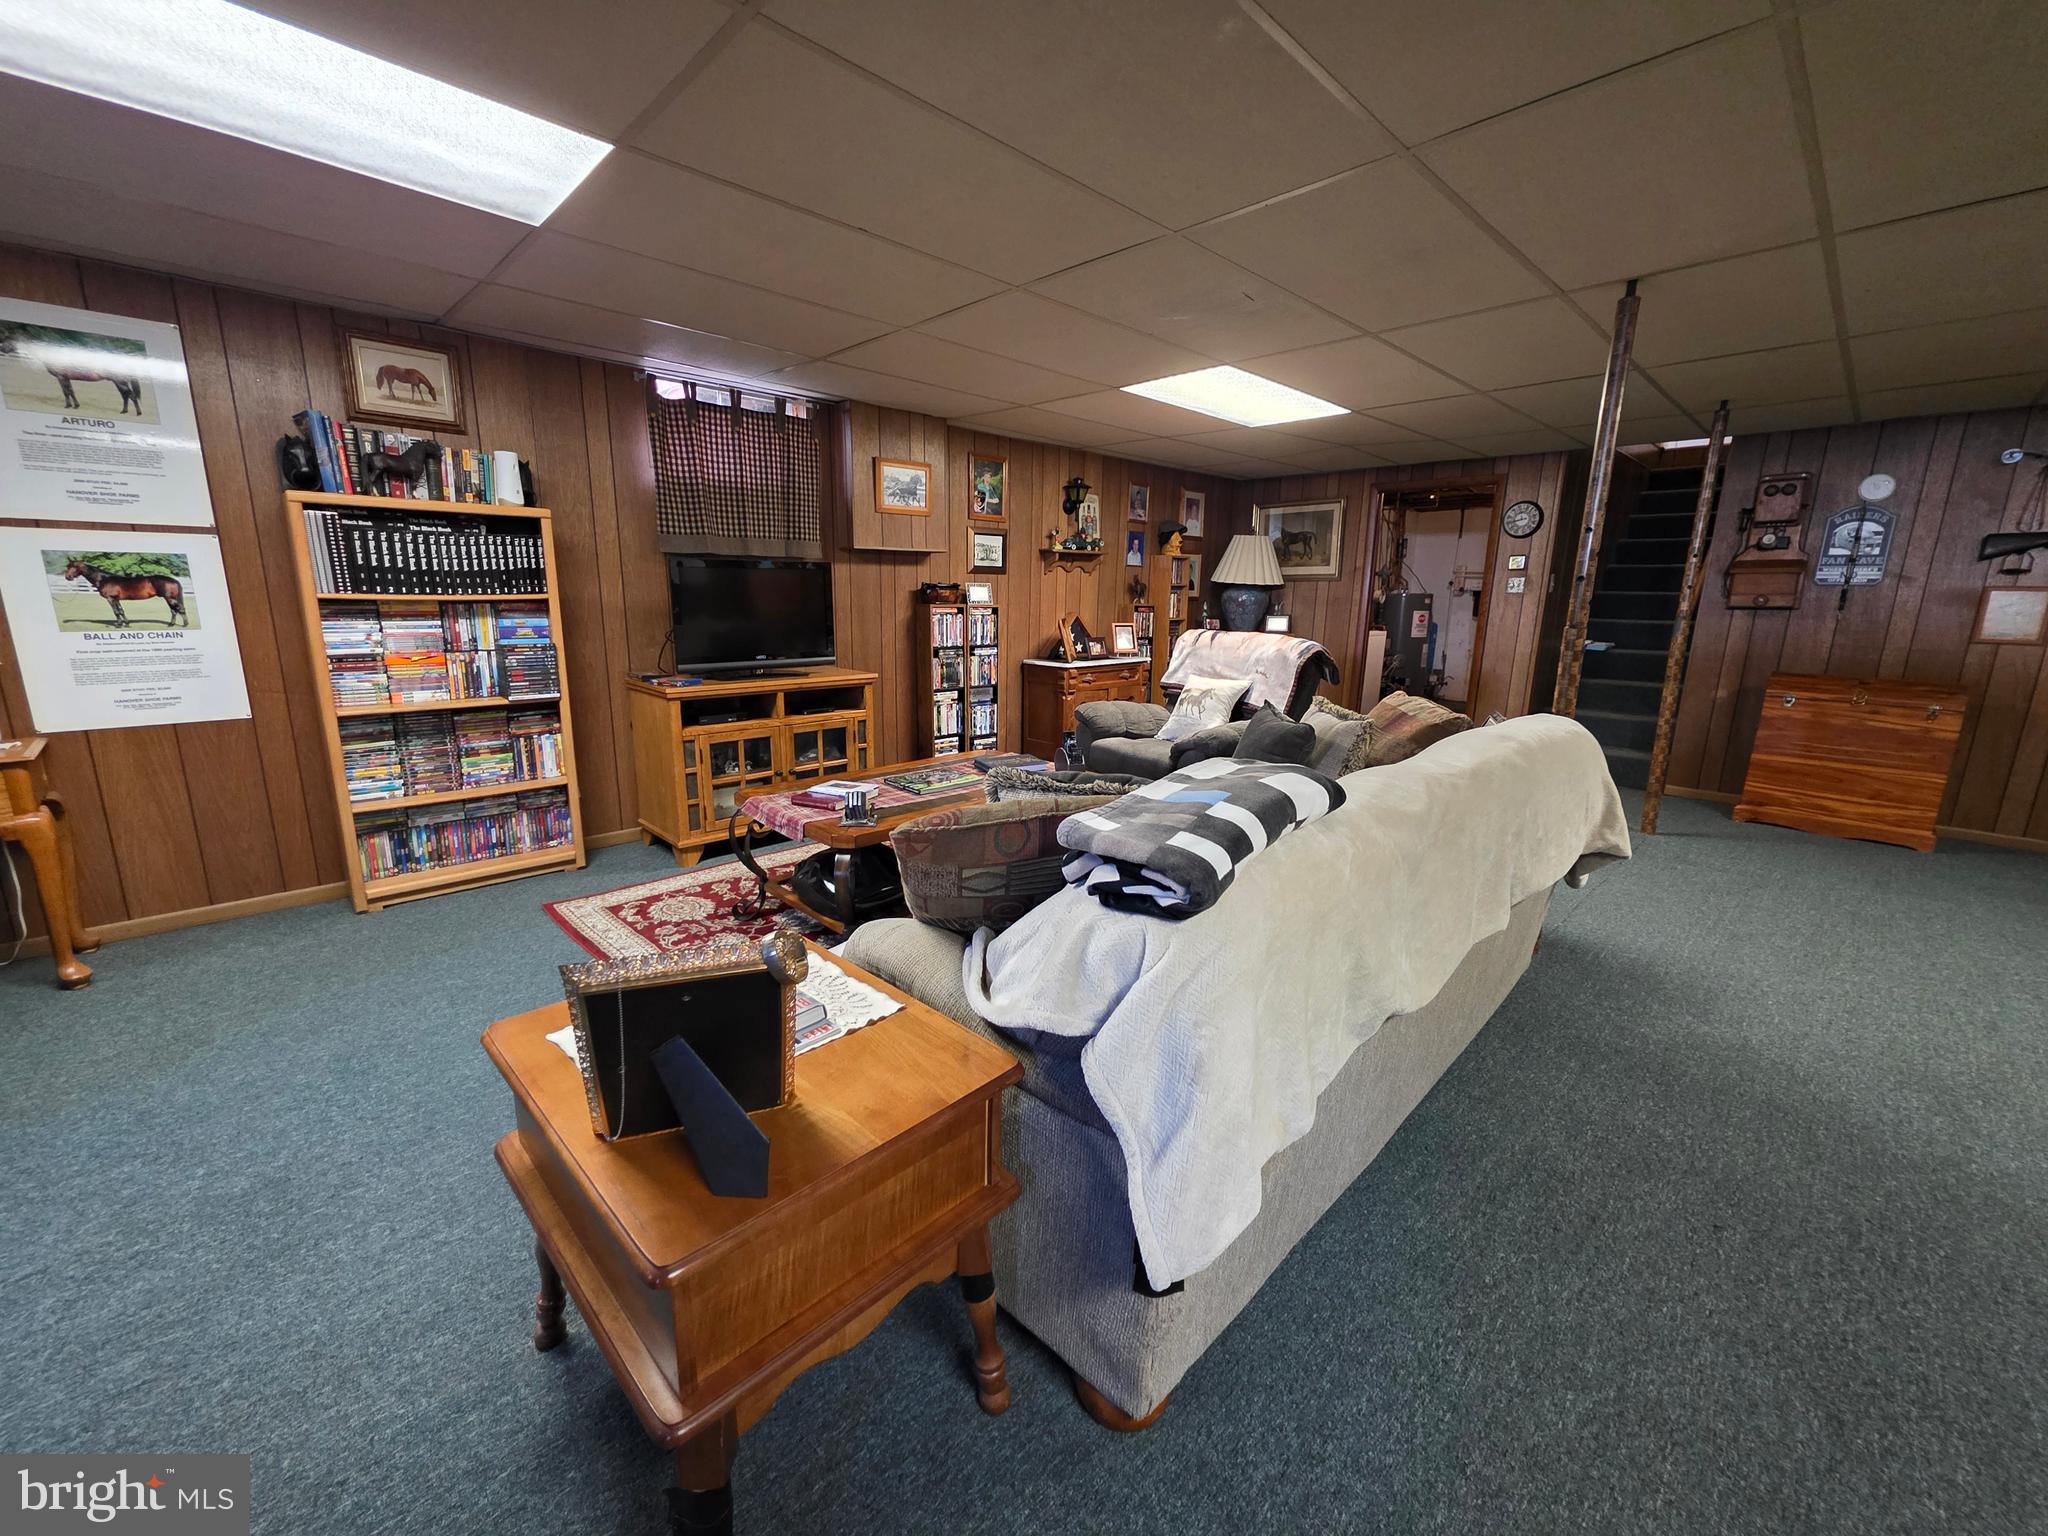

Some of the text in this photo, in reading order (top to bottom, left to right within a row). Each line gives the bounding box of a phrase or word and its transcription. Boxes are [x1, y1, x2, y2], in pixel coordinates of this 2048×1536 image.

[61, 417, 115, 428] ARTURO
[1834, 511, 1890, 525] RAIERS
[1822, 557, 1846, 565] FAN
[120, 632, 144, 640] AND
[147, 631, 184, 639] CHAIN
